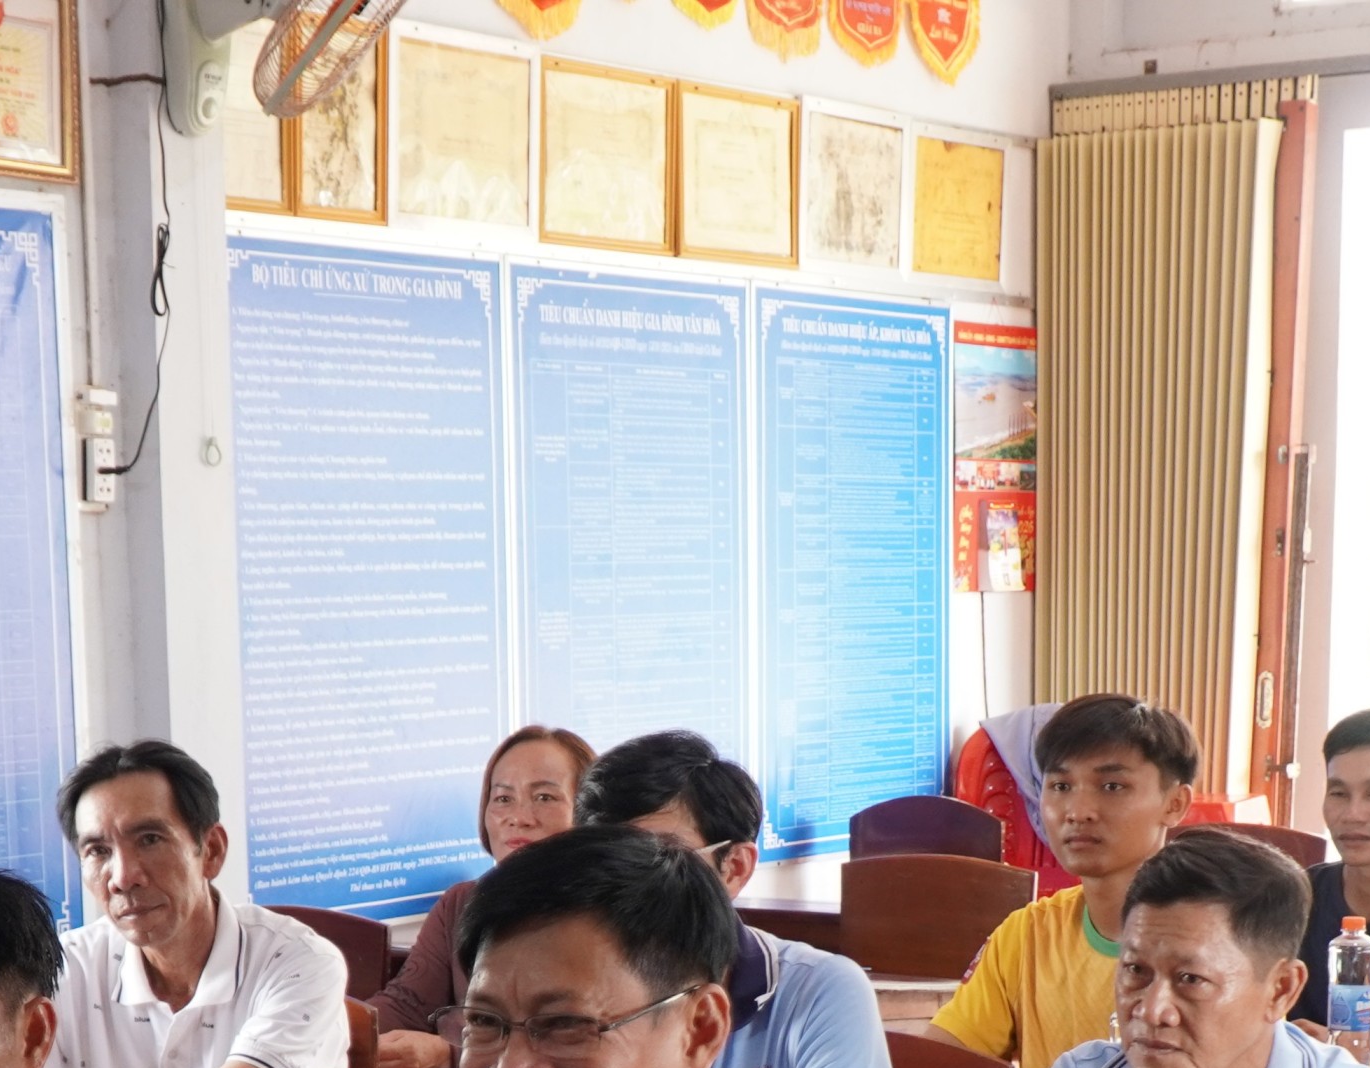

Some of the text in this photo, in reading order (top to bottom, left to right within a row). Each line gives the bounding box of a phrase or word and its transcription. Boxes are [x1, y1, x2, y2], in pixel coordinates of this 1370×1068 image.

[252, 261, 462, 299] BỘ TIÊU CHÍ ỨNG XỬ TRONG GIA ĐÌNH
[539, 301, 561, 323] TIÊU
[562, 298, 595, 327] CHUẨN
[595, 309, 621, 328] DANH
[622, 309, 643, 332] HIỆU
[645, 311, 661, 331] GIA
[662, 310, 683, 331] ĐÌNH
[685, 312, 703, 334] VĂN
[782, 313, 800, 333] TIÊU
[801, 313, 827, 335] CHUẨN
[827, 321, 848, 337] DANH
